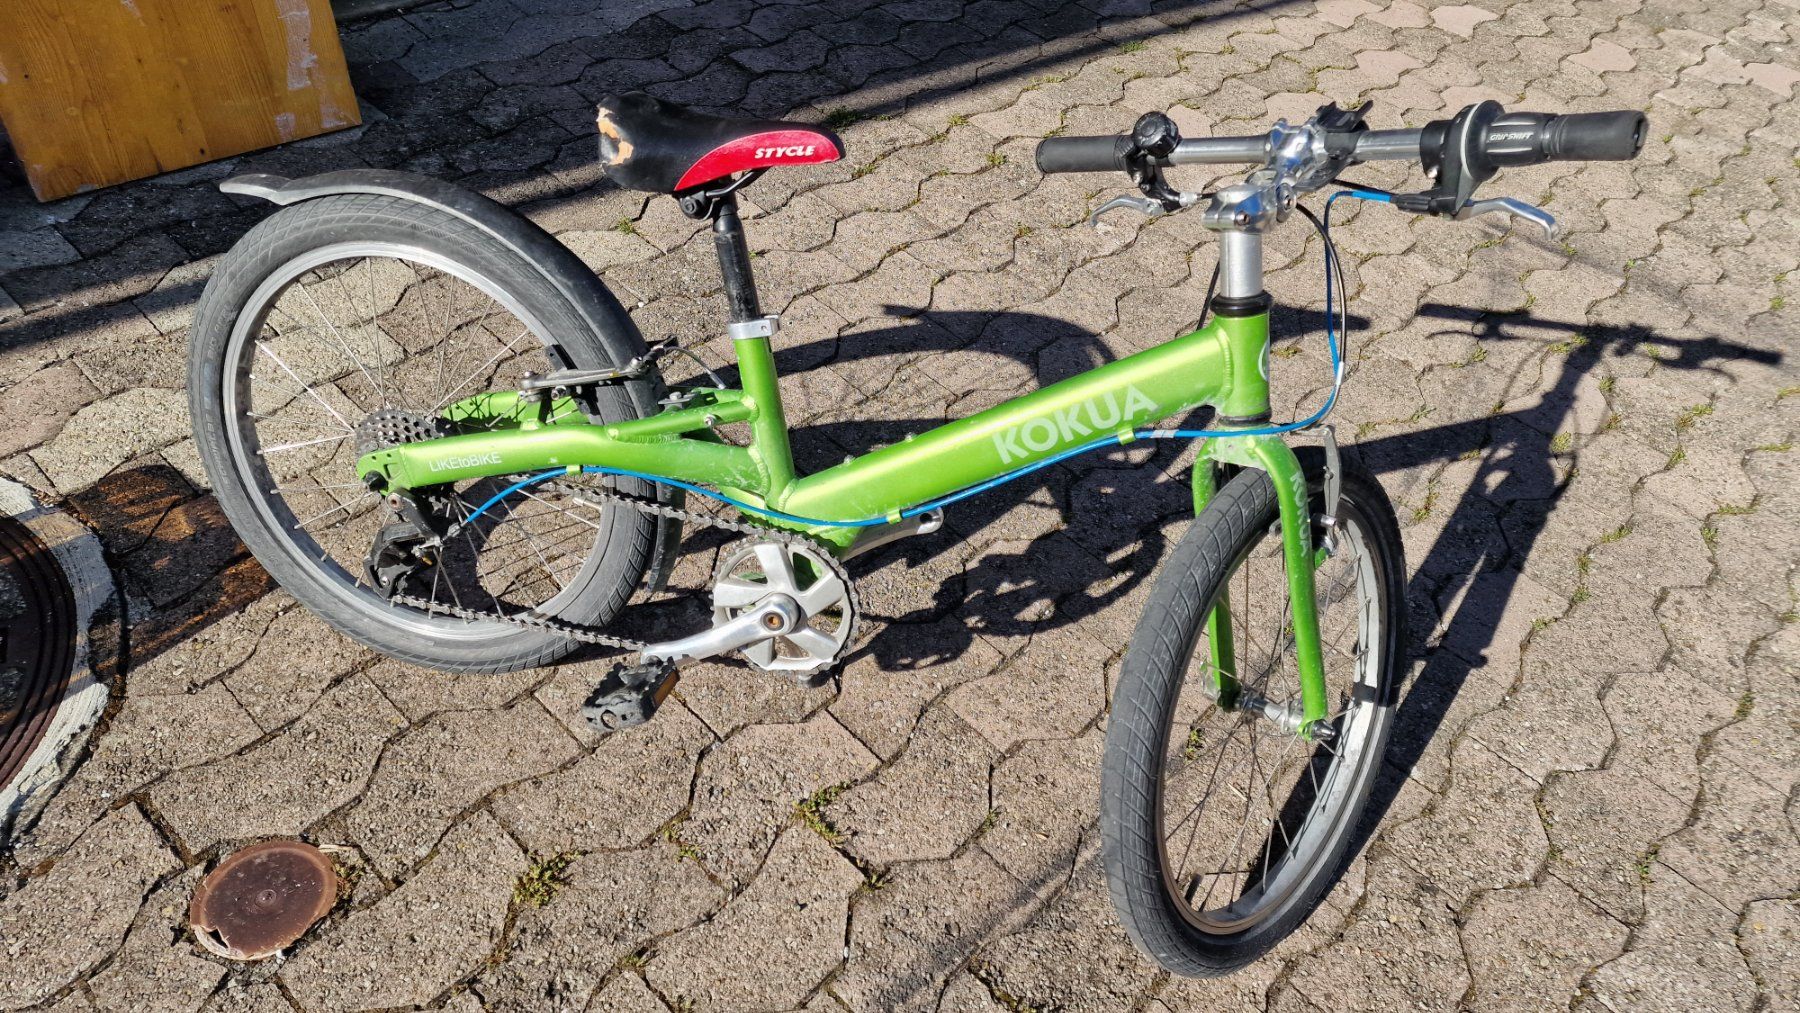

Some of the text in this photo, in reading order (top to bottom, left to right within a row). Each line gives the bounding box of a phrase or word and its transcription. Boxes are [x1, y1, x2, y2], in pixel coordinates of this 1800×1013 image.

[755, 145, 816, 159] STYCLE
[992, 385, 1158, 465] KOKUA
[428, 452, 503, 472] LIKEtoBIKE
[1290, 471, 1310, 557] KOKUA
